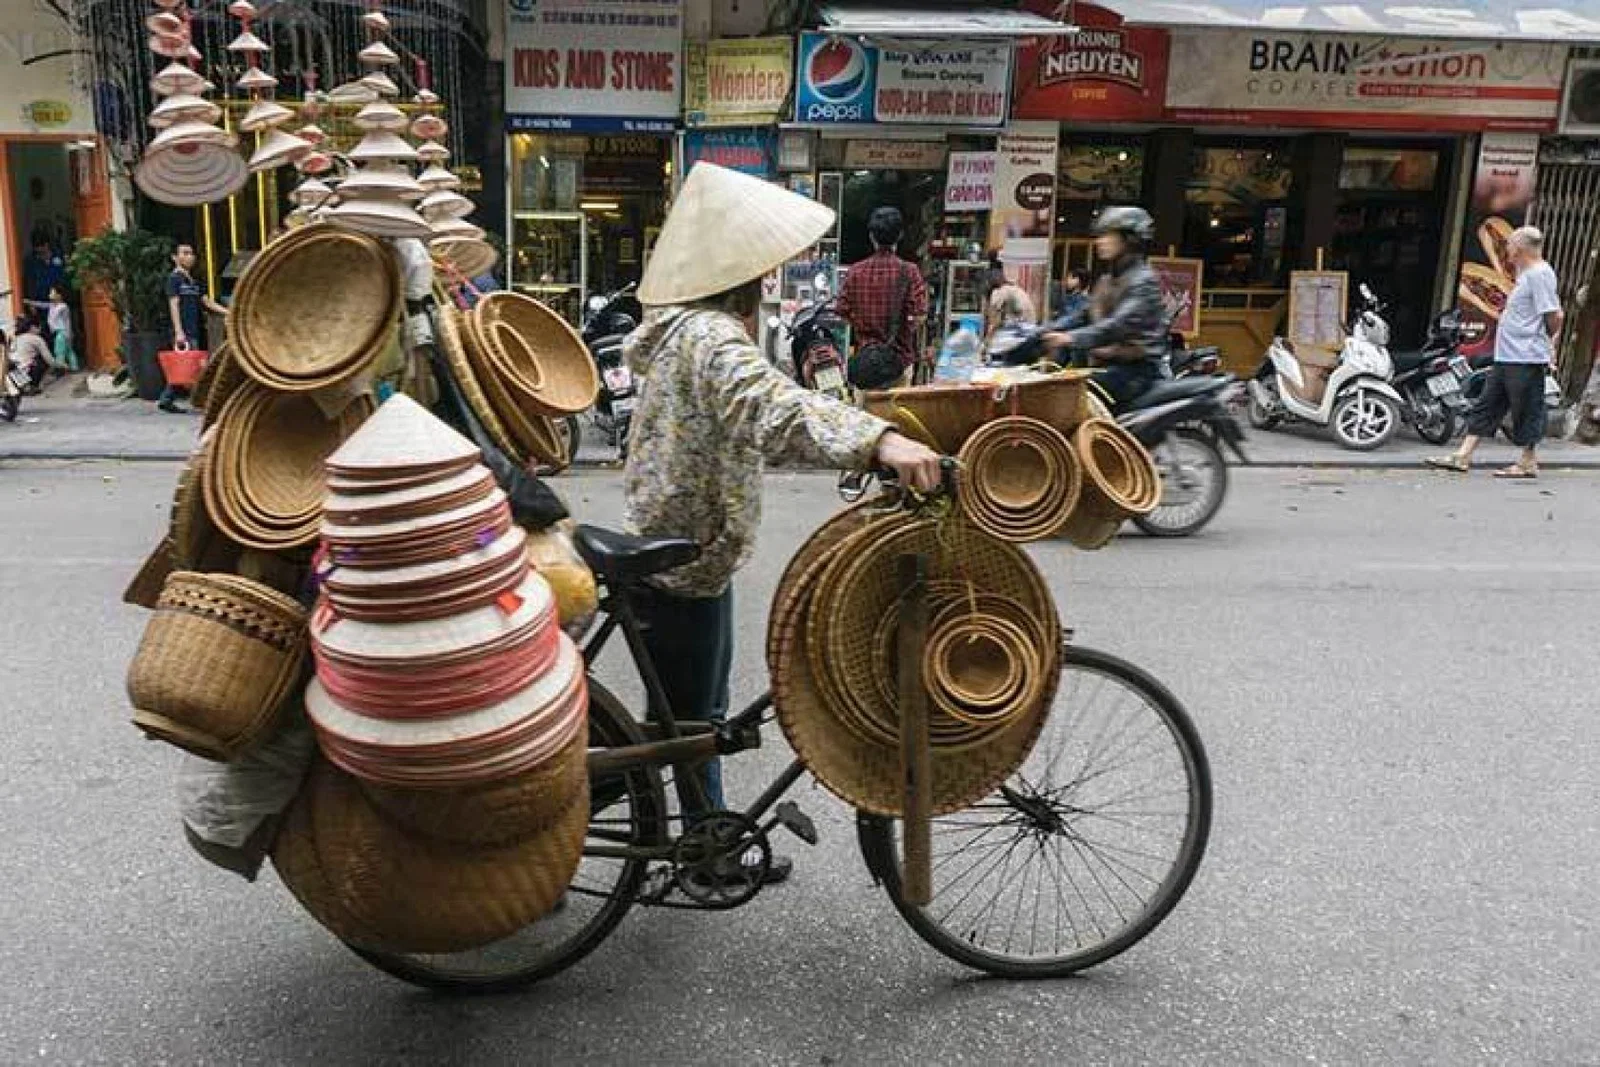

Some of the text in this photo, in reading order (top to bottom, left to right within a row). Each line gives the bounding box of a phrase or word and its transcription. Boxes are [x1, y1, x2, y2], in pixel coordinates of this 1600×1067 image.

[513, 48, 561, 88] KIDS
[565, 48, 606, 90] AND
[611, 50, 674, 92] STONE
[1249, 40, 1359, 74] BRAIN
[807, 103, 863, 122] pepsi
